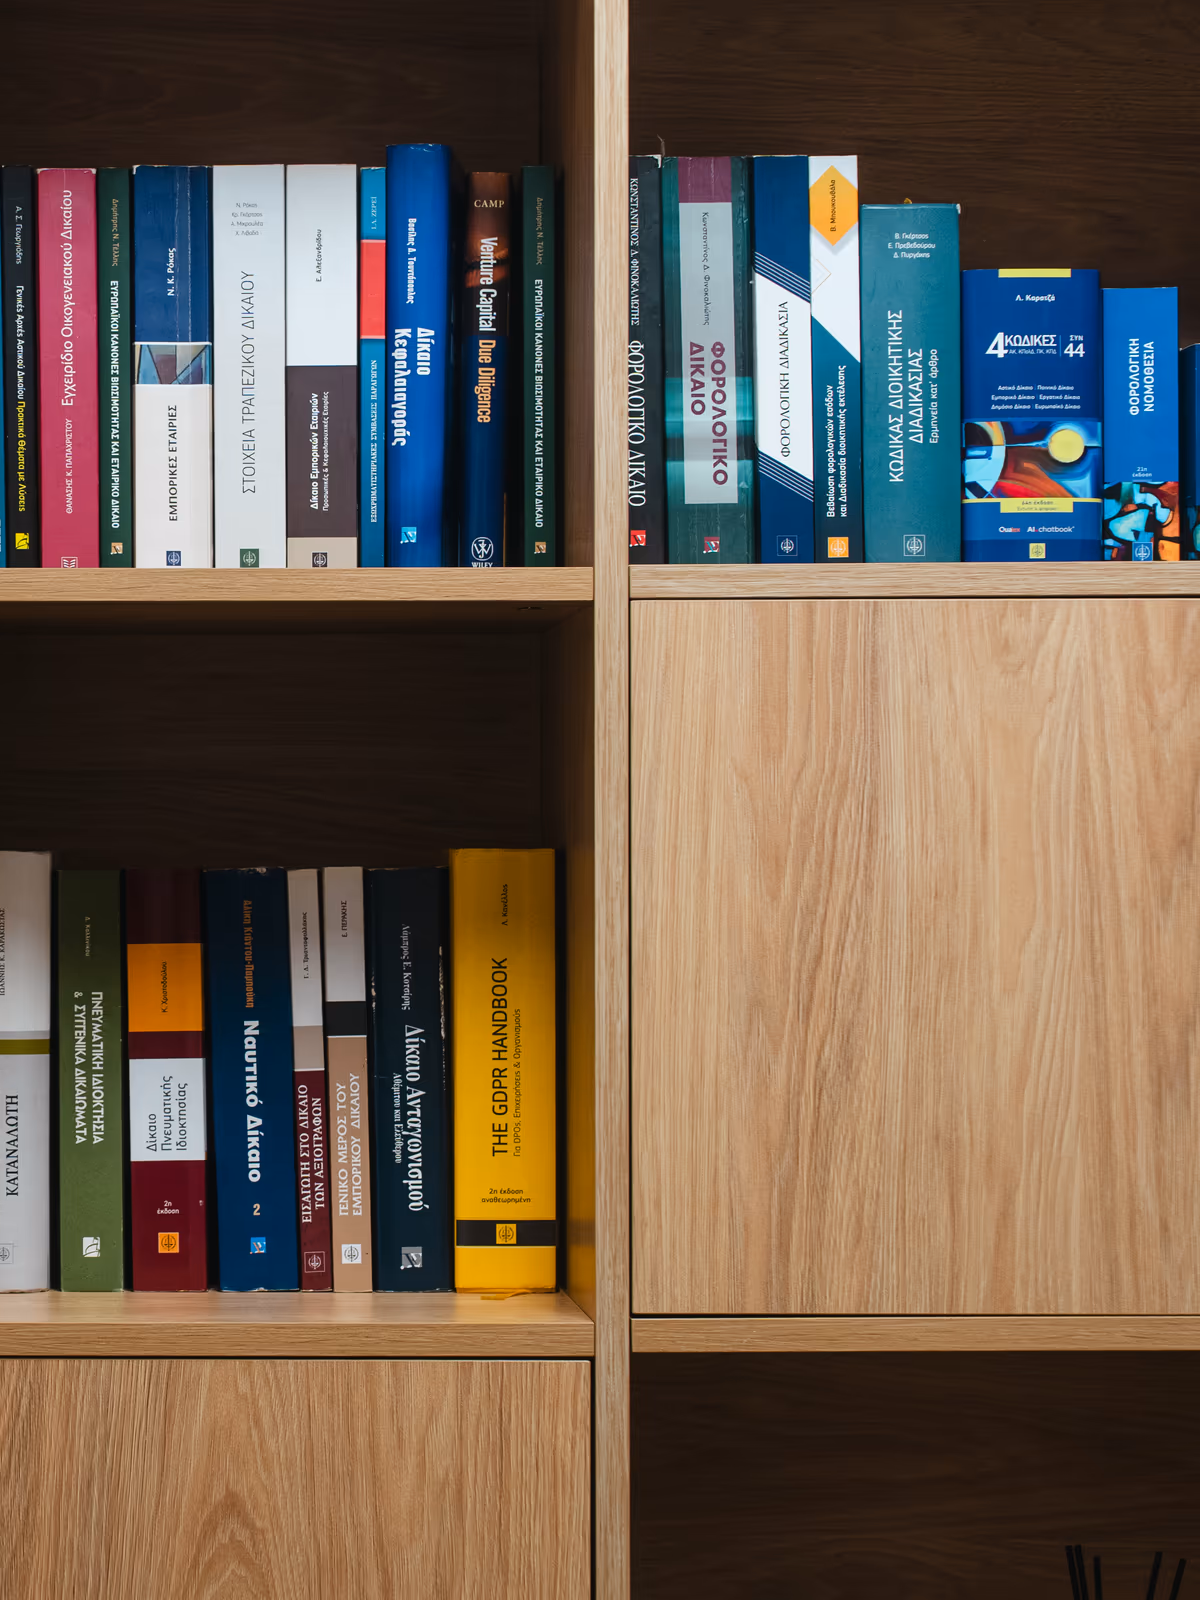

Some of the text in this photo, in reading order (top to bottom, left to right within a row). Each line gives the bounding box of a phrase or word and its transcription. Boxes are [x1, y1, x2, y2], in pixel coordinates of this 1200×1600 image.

[474, 200, 505, 208] CAMP
[630, 178, 640, 326] ΚΩΝΣΤΑΝΤΙΝΟΣ Δ. ΦΙΝΟΚΑΛΙΩΤΗΣ
[60, 190, 76, 405] Εγχειρίδιο Οικογενειακού Δικαίου
[416, 327, 435, 375] Δίκαιο
[474, 237, 498, 423] Venture Capital Due Diligence
[985, 332, 1057, 358] 4 ΚΩΔΙΚΕΣ
[1025, 294, 1055, 303] Καρατζά
[1064, 343, 1085, 357] 44
[15, 285, 26, 512] Γενικές Αρχές Αστικού Δικαίου Πρακτικά Θέματα με Λύσεις
[110, 280, 120, 529] ΕΥΡΩΠΑΪΚΟΙ ΚΑΝΟΝΕΣ ΒΙΩΣΙΜΟΤΗΤΑΣ ΚΑΙ ΕΤΑΙΡΙΚΟ ΔΙΚΑΙΟ
[241, 271, 256, 494] ΣΤΟΙΧΕΙΑ ΤΡΑΠΕΖΙΚΟΥ ΔΙΚΑΙΟΥ
[391, 329, 412, 446] Κεφαλαιαγοράς
[534, 279, 544, 528] ΕΥΡΩΠΑΪΚΟΙ ΚΑΝΟΝΕΣ ΒΙΩΣΙΜΟΤΗΤΑΣ ΚΑΙ ΕΤΑΙΡΙΚΟ ΔΙΚΑΙΟ
[628, 340, 646, 507] ΦΟΡΟΛΟΓΙΚΟ ΔΙΚΑΙΟ
[690, 342, 705, 415] ΔΙΚΑΙΟ
[711, 341, 728, 485] ΦΟΡΟΛΟΓΙΚΟ
[778, 302, 791, 457] ΦΟΡΟΛΟΓΙΚΗ ΔΙΑΔΙΚΑΣΙΑ
[888, 310, 903, 482] ΚΩΔΙΚΑΣ ΔΙΟΙΚΗΤΙΚΗΣ
[908, 348, 923, 443] ΔΙΑΔΙΚΑΣΙΑΣ
[1129, 338, 1140, 416] ΦΟΡΟΛΟΓΙΚΗ
[1143, 341, 1155, 412] ΝΟΜΟΘΕΣΙΑ
[168, 405, 178, 521] ΕΜΠΟΡΙΚΕΣ ΕΤΑΙΡΙΕΣ
[91, 991, 104, 1144] ΠΝΕΥΜΑΤΙΚΗ ΙΔΙΟΚΤΗΣΙΑ
[160, 1076, 174, 1151] Πνευματικής
[176, 1083, 188, 1151] Ιδιοκτησίας
[243, 1020, 264, 1182] Ναυτικό Δίκαιο
[402, 1025, 429, 1211] Δίκαιο Ανταγωνισμού
[491, 958, 508, 1156] THE GDPR HANDBOOK
[6, 1095, 19, 1196] ΚΑΤΑΝΑΛΩΤΗ
[146, 1113, 158, 1152] Δίκαιο
[350, 1073, 362, 1216] ΕΜΠΟΡΙΚΟΥ ΔΙΚΑΙΟΥ
[253, 1204, 260, 1215] 2
